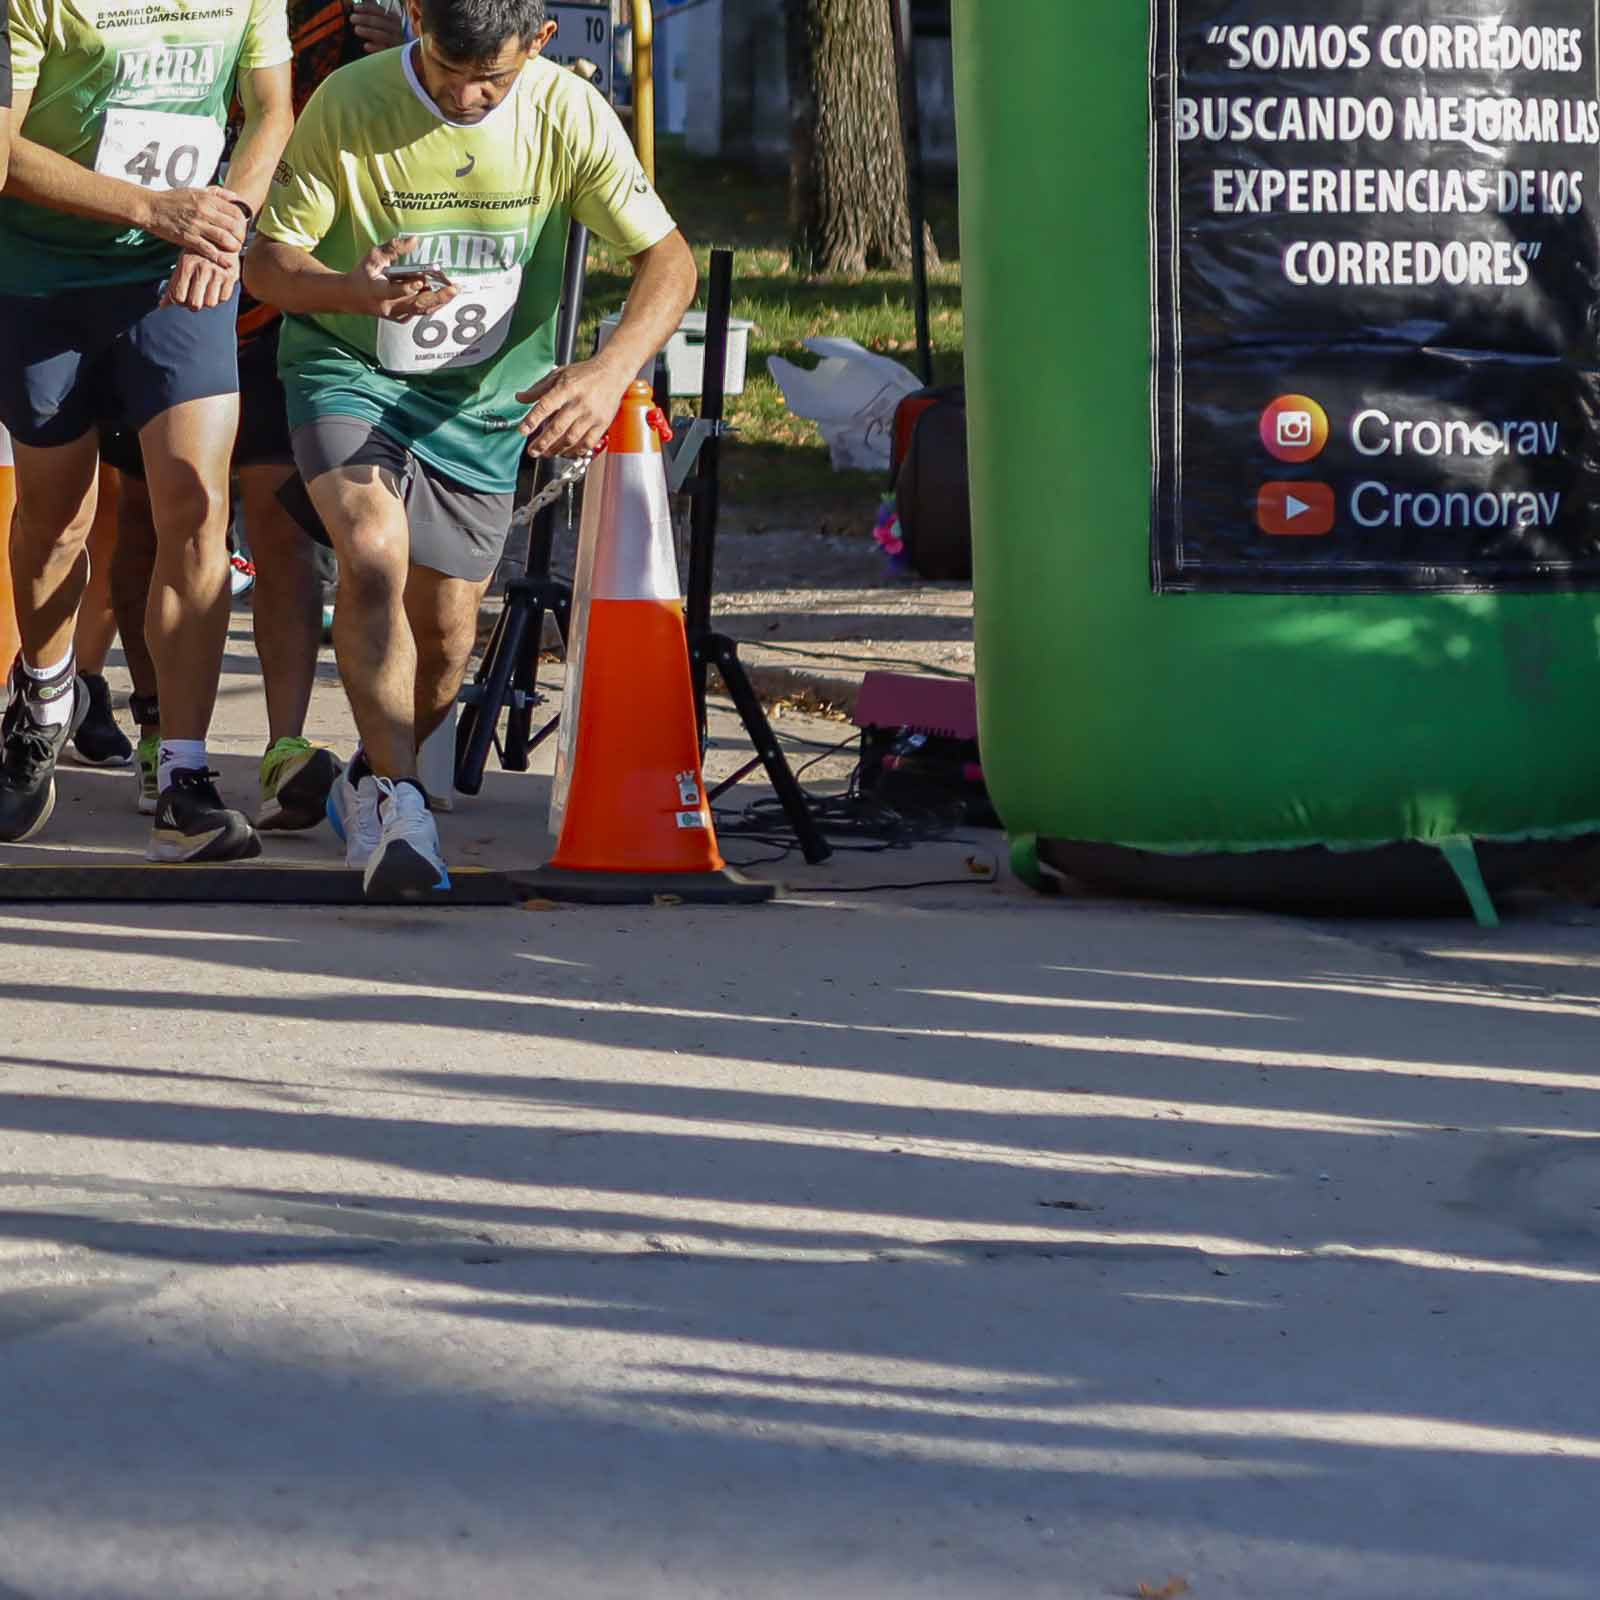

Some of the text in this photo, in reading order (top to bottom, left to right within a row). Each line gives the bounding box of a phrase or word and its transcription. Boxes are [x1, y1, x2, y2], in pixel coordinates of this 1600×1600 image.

[1381, 24, 1583, 72] CORREDORES
[1177, 96, 1600, 145] BUSCANDO MEJORAR LAS
[123, 140, 201, 189] 40
[1212, 168, 1583, 215] EXPERIENCIAS DE LOS
[411, 303, 487, 349] 68
[1351, 408, 1558, 457] Cronorav
[1350, 479, 1560, 527] Cronorav
